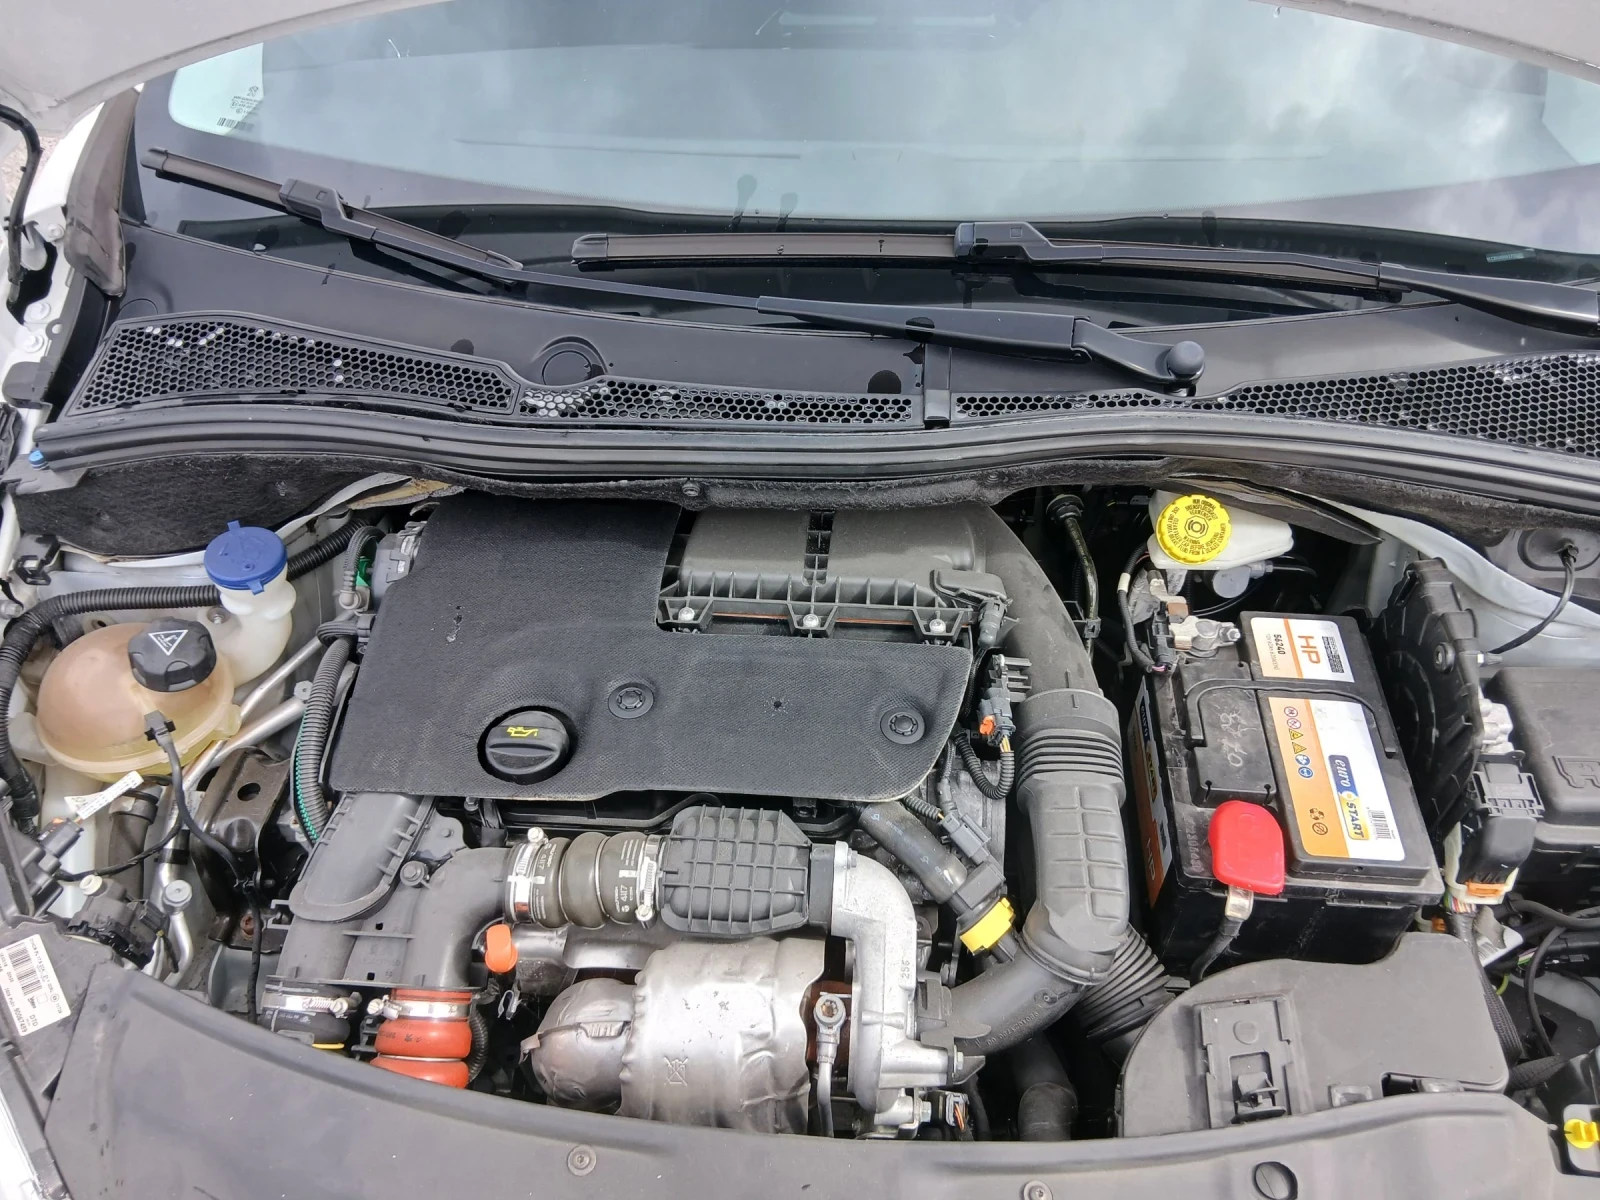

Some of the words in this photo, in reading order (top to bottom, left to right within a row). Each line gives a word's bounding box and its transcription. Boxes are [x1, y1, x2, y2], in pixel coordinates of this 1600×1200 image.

[1273, 634, 1286, 655] 56240
[1298, 635, 1320, 665] HP
[1334, 759, 1351, 787] euro
[1346, 802, 1364, 838] START
